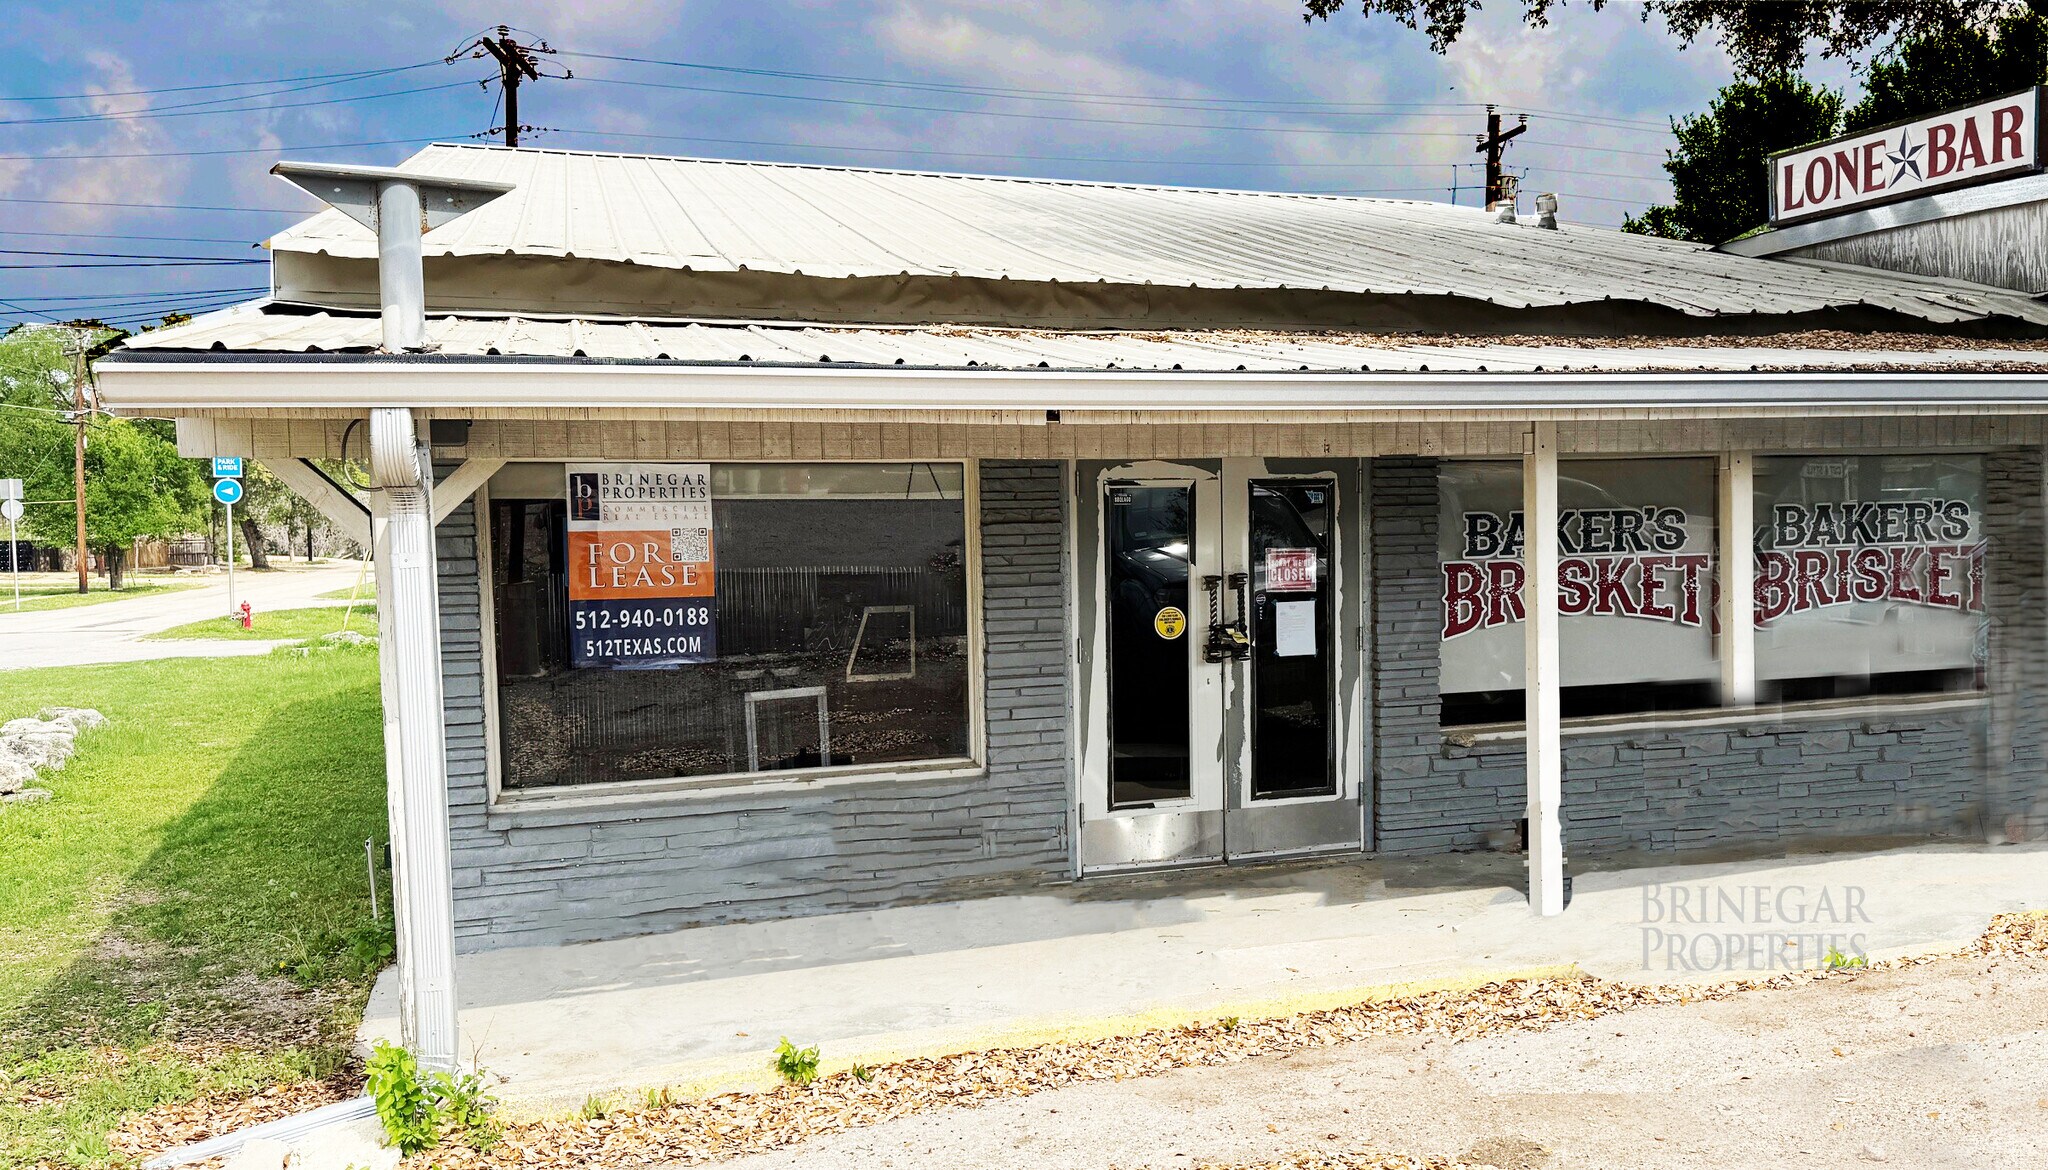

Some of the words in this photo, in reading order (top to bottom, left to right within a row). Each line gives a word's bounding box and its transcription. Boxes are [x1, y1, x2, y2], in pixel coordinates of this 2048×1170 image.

[1783, 139, 1887, 212] LONE
[1926, 104, 2025, 180] BAR
[602, 473, 707, 486] BRINEGAR
[602, 486, 706, 499] PROPERTIES
[603, 504, 708, 512] COMMERCIAL
[603, 512, 640, 521] REAL
[654, 512, 709, 520] ESTATE
[1773, 498, 1971, 549] BAKER'S
[588, 542, 665, 565] FOR
[589, 564, 698, 588] LEASE
[1270, 568, 1312, 582] CLOSED
[1442, 553, 1709, 641] BRSKET
[576, 607, 709, 630] 512-940-0188
[586, 636, 701, 657] 512TEXAS.COM
